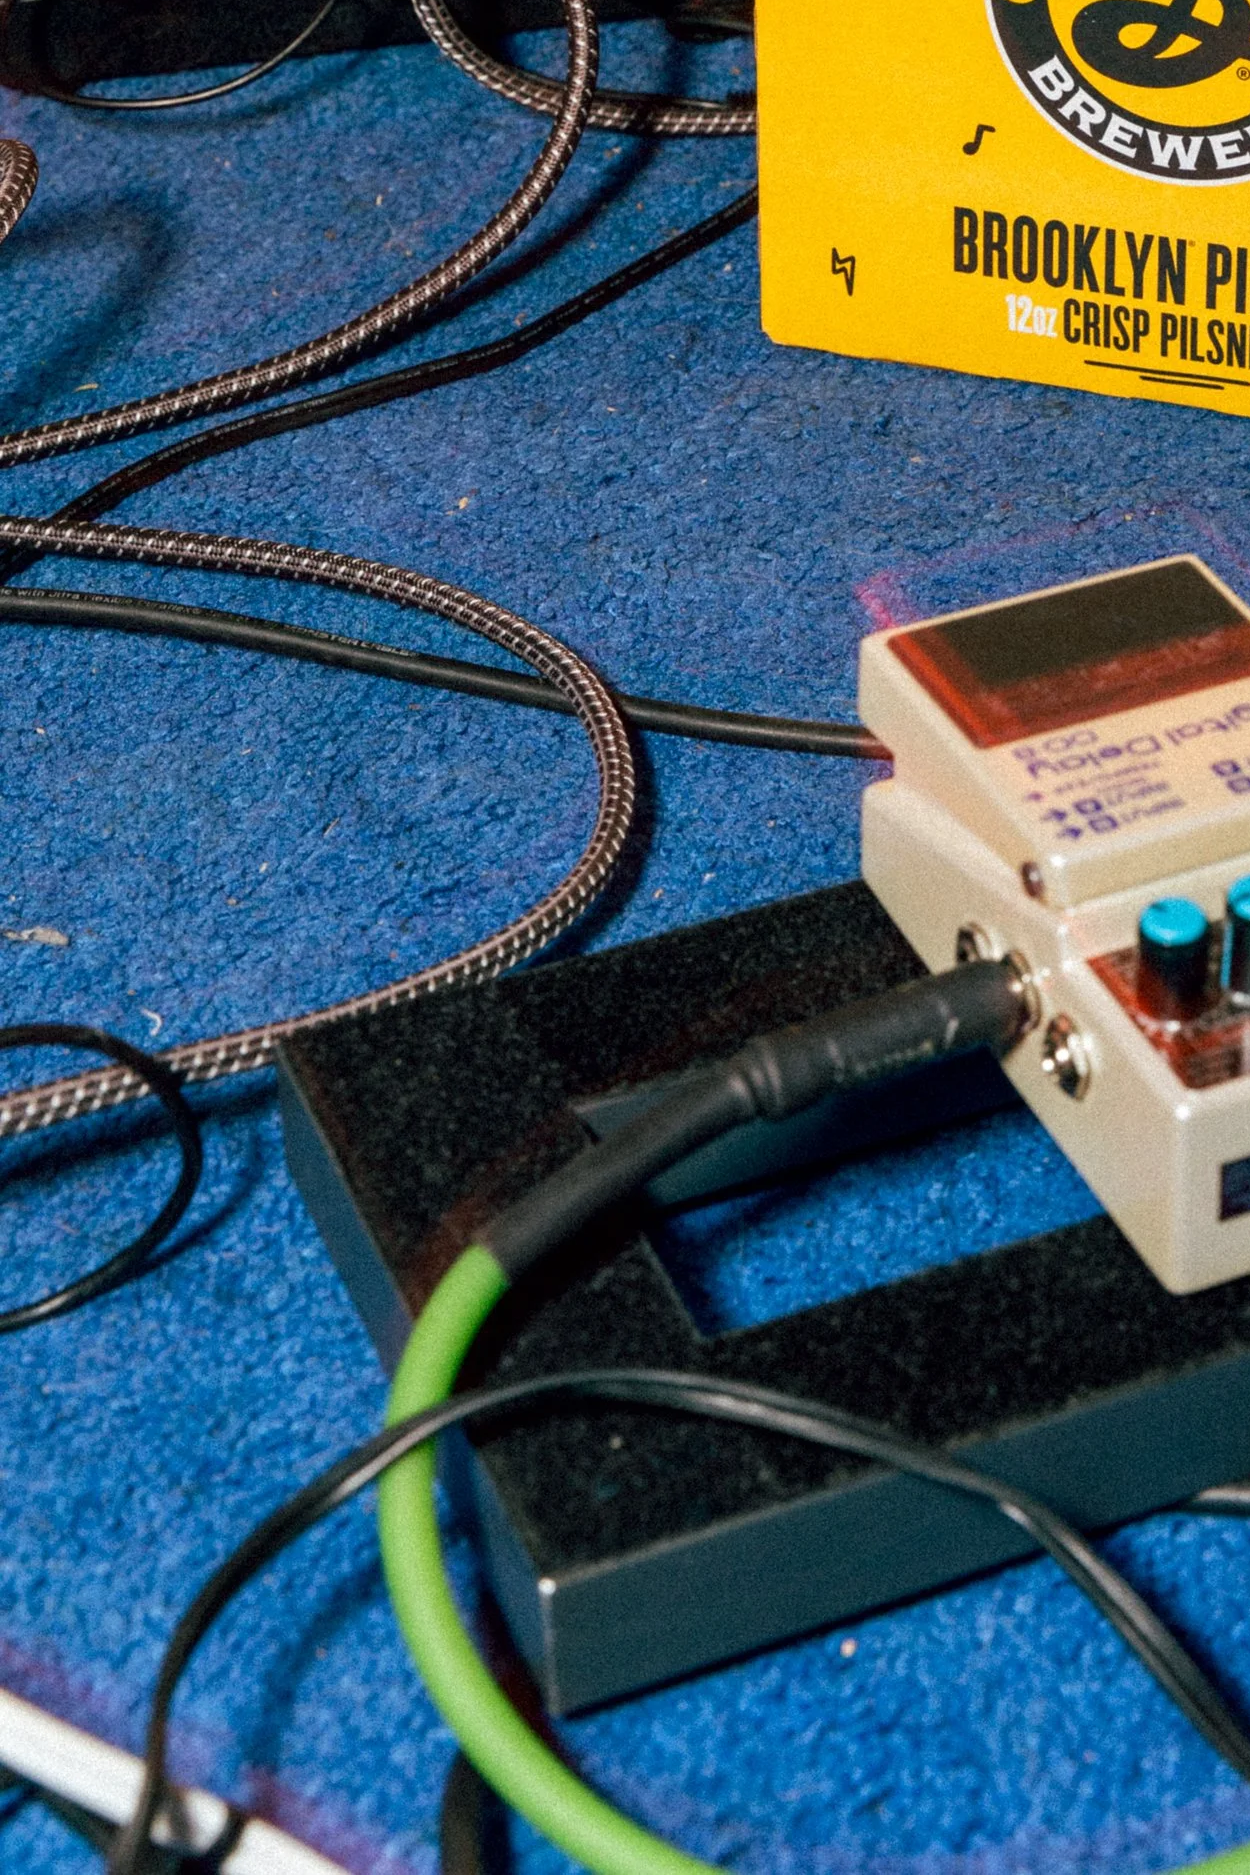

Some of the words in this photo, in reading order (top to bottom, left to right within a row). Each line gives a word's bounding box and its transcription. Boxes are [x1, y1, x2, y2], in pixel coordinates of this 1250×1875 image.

[953, 206, 1188, 306] BROOKLYN
[1063, 298, 1150, 353] CRISP
[1026, 734, 1162, 778] Delay
